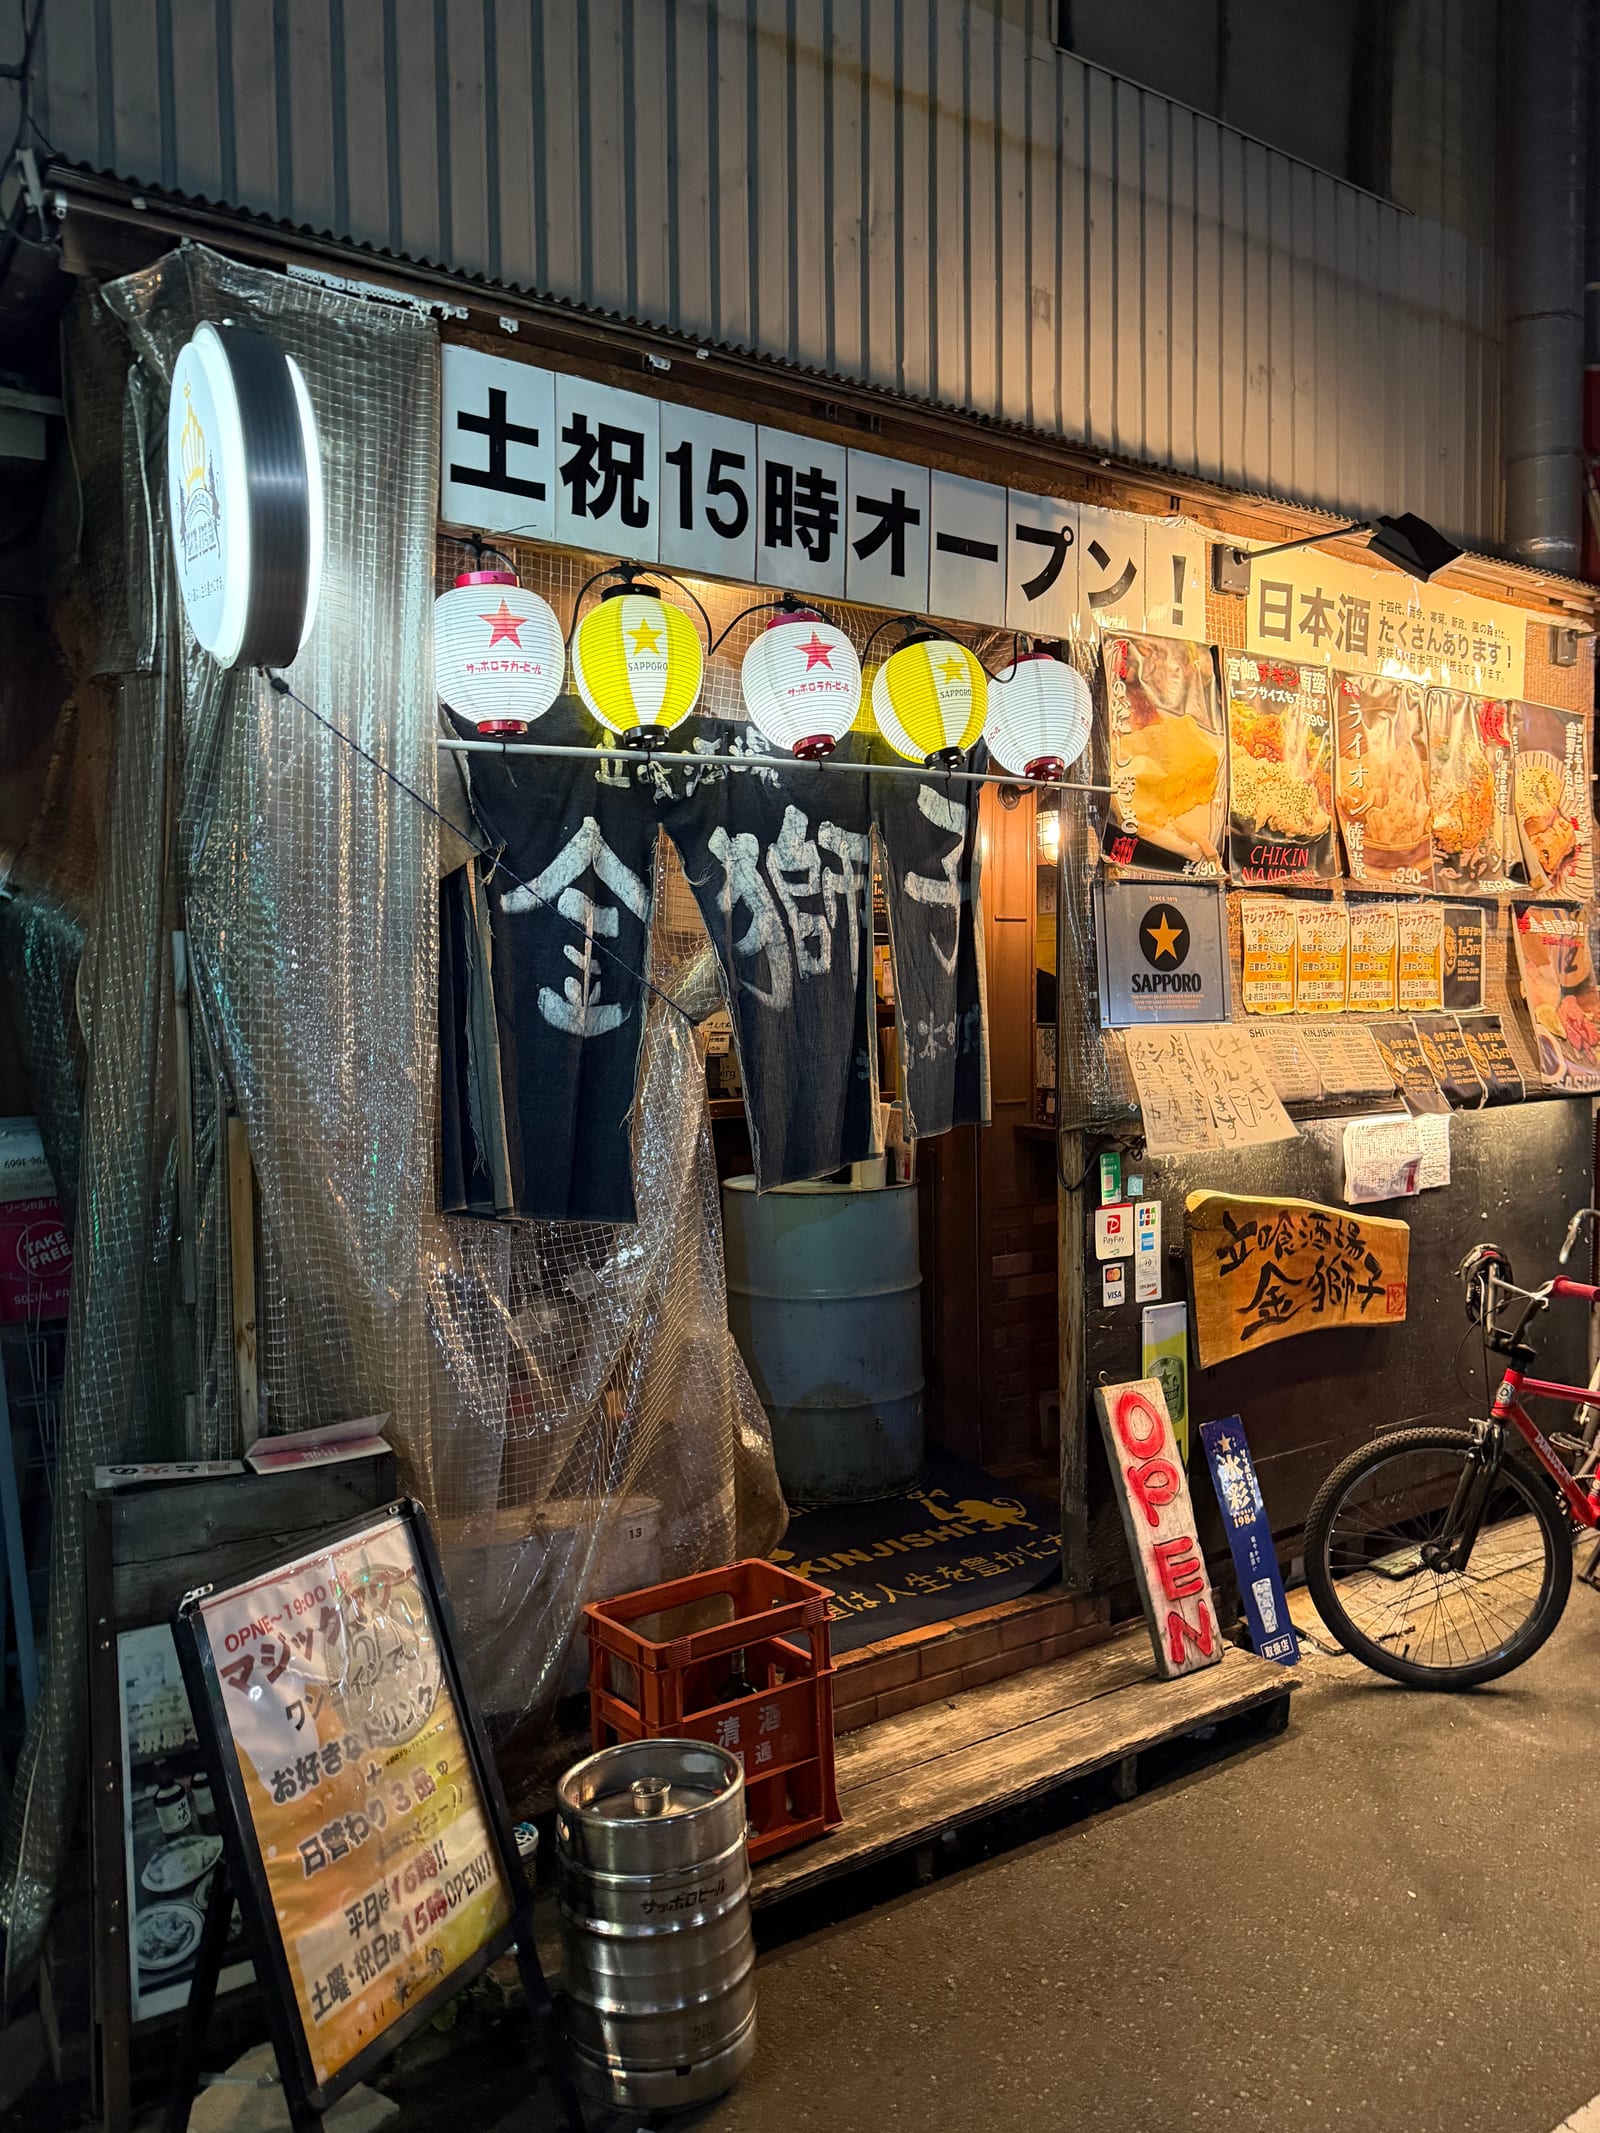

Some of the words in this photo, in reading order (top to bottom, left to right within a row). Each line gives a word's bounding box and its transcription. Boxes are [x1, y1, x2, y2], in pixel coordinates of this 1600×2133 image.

[1259, 579, 1371, 656] 日本酒
[628, 661, 668, 671] SAPPORO
[1227, 657, 1326, 694] 宮崎チキン南蛮
[940, 688, 972, 699] SAPPORO
[1250, 845, 1309, 867] CHIKIN
[1243, 911, 1294, 924] マジックアワー
[1298, 912, 1347, 925] マジックアワー
[1131, 973, 1202, 993] SAPPORO
[1302, 1028, 1336, 1038] KINJISHI
[23, 1231, 66, 1255] TAKE
[1103, 1236, 1125, 1245] PayPay
[1216, 1209, 1366, 1277] 立喰酒場
[30, 1246, 73, 1269] FREE
[1107, 1290, 1122, 1299] VISA
[1236, 1252, 1386, 1341] 金獅子
[1117, 1390, 1214, 1665] OPEN
[1233, 1512, 1257, 1528] 1984
[629, 1528, 642, 1540] 13
[790, 1522, 976, 1580] KINJISHI
[1264, 1639, 1290, 1658] 取扱店
[715, 1703, 782, 1747] 清酒
